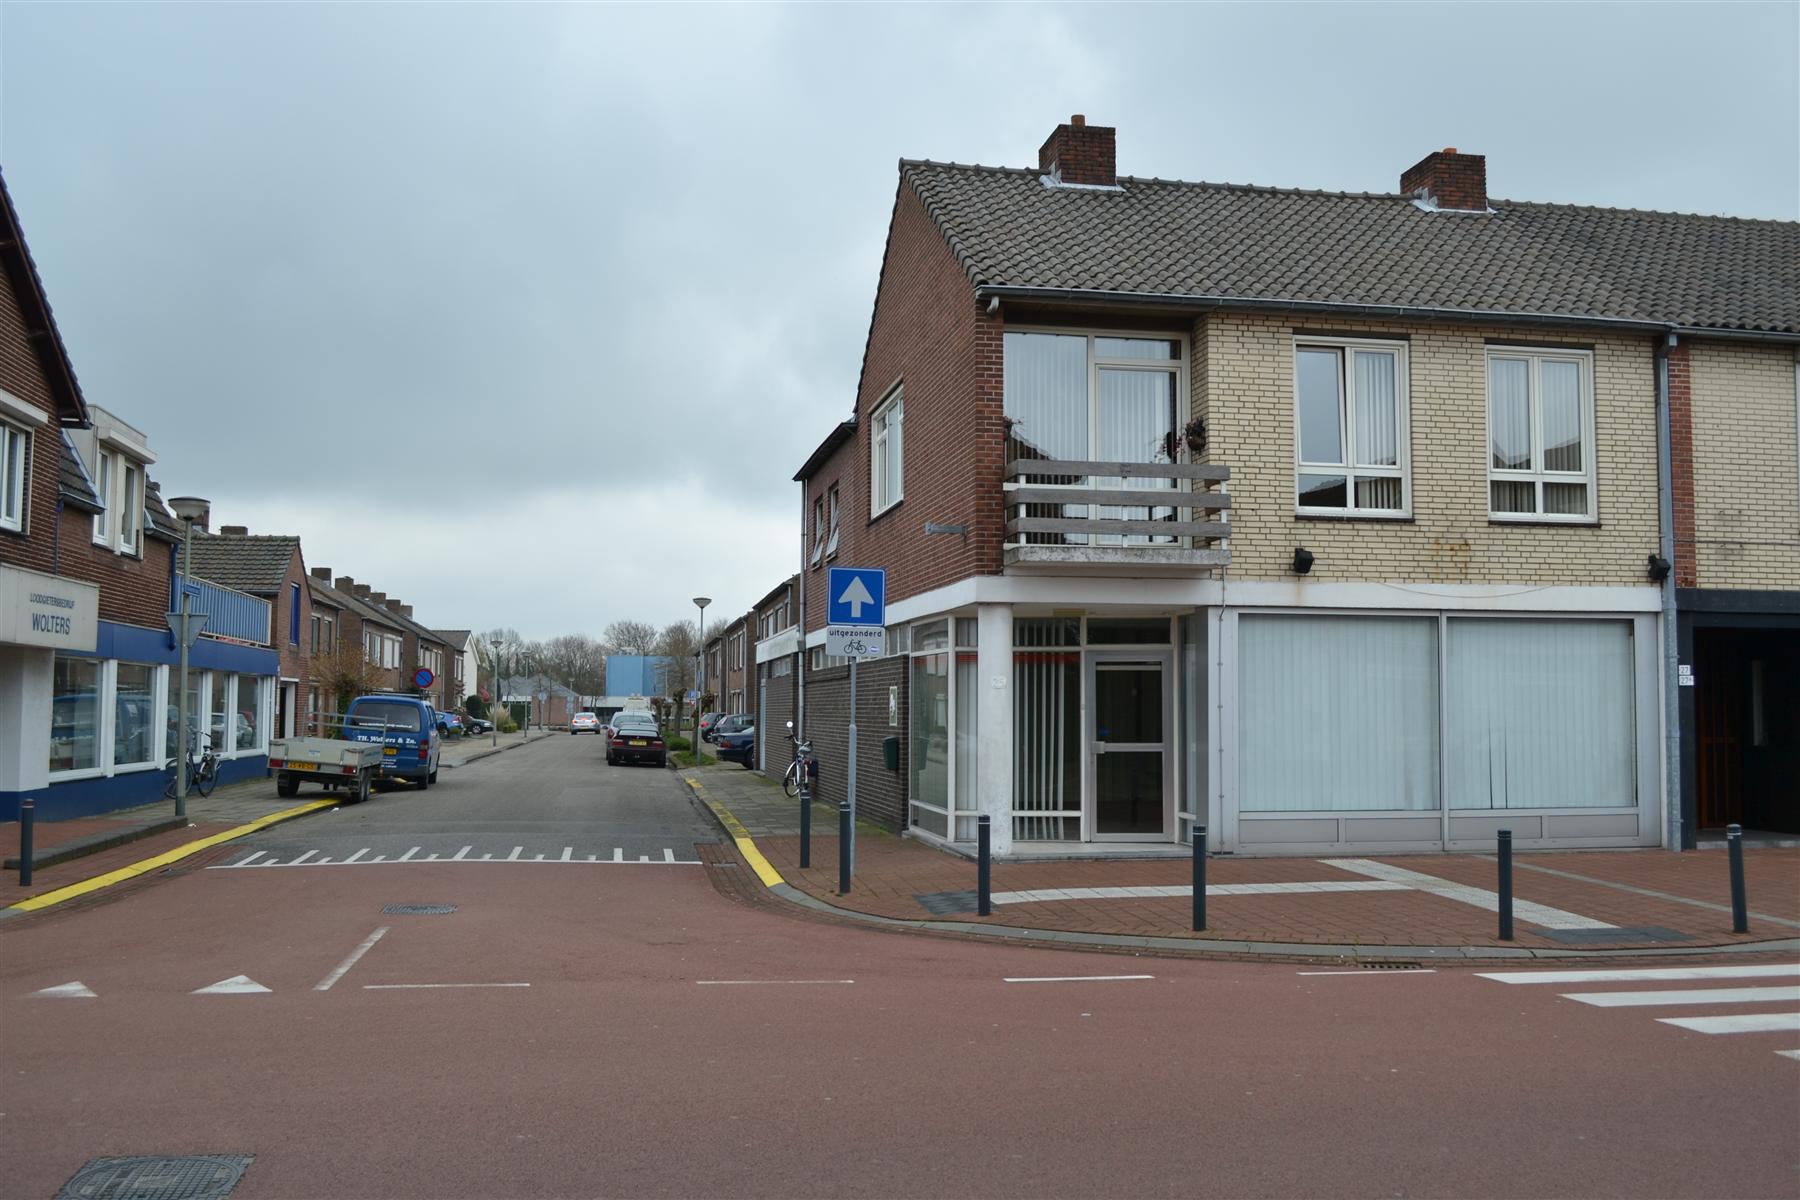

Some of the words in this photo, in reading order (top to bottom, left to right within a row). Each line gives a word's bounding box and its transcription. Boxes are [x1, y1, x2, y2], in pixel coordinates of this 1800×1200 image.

[32, 612, 71, 635] WOLTERS
[829, 630, 882, 638] uitgezonderd
[370, 735, 396, 743] Wolers
